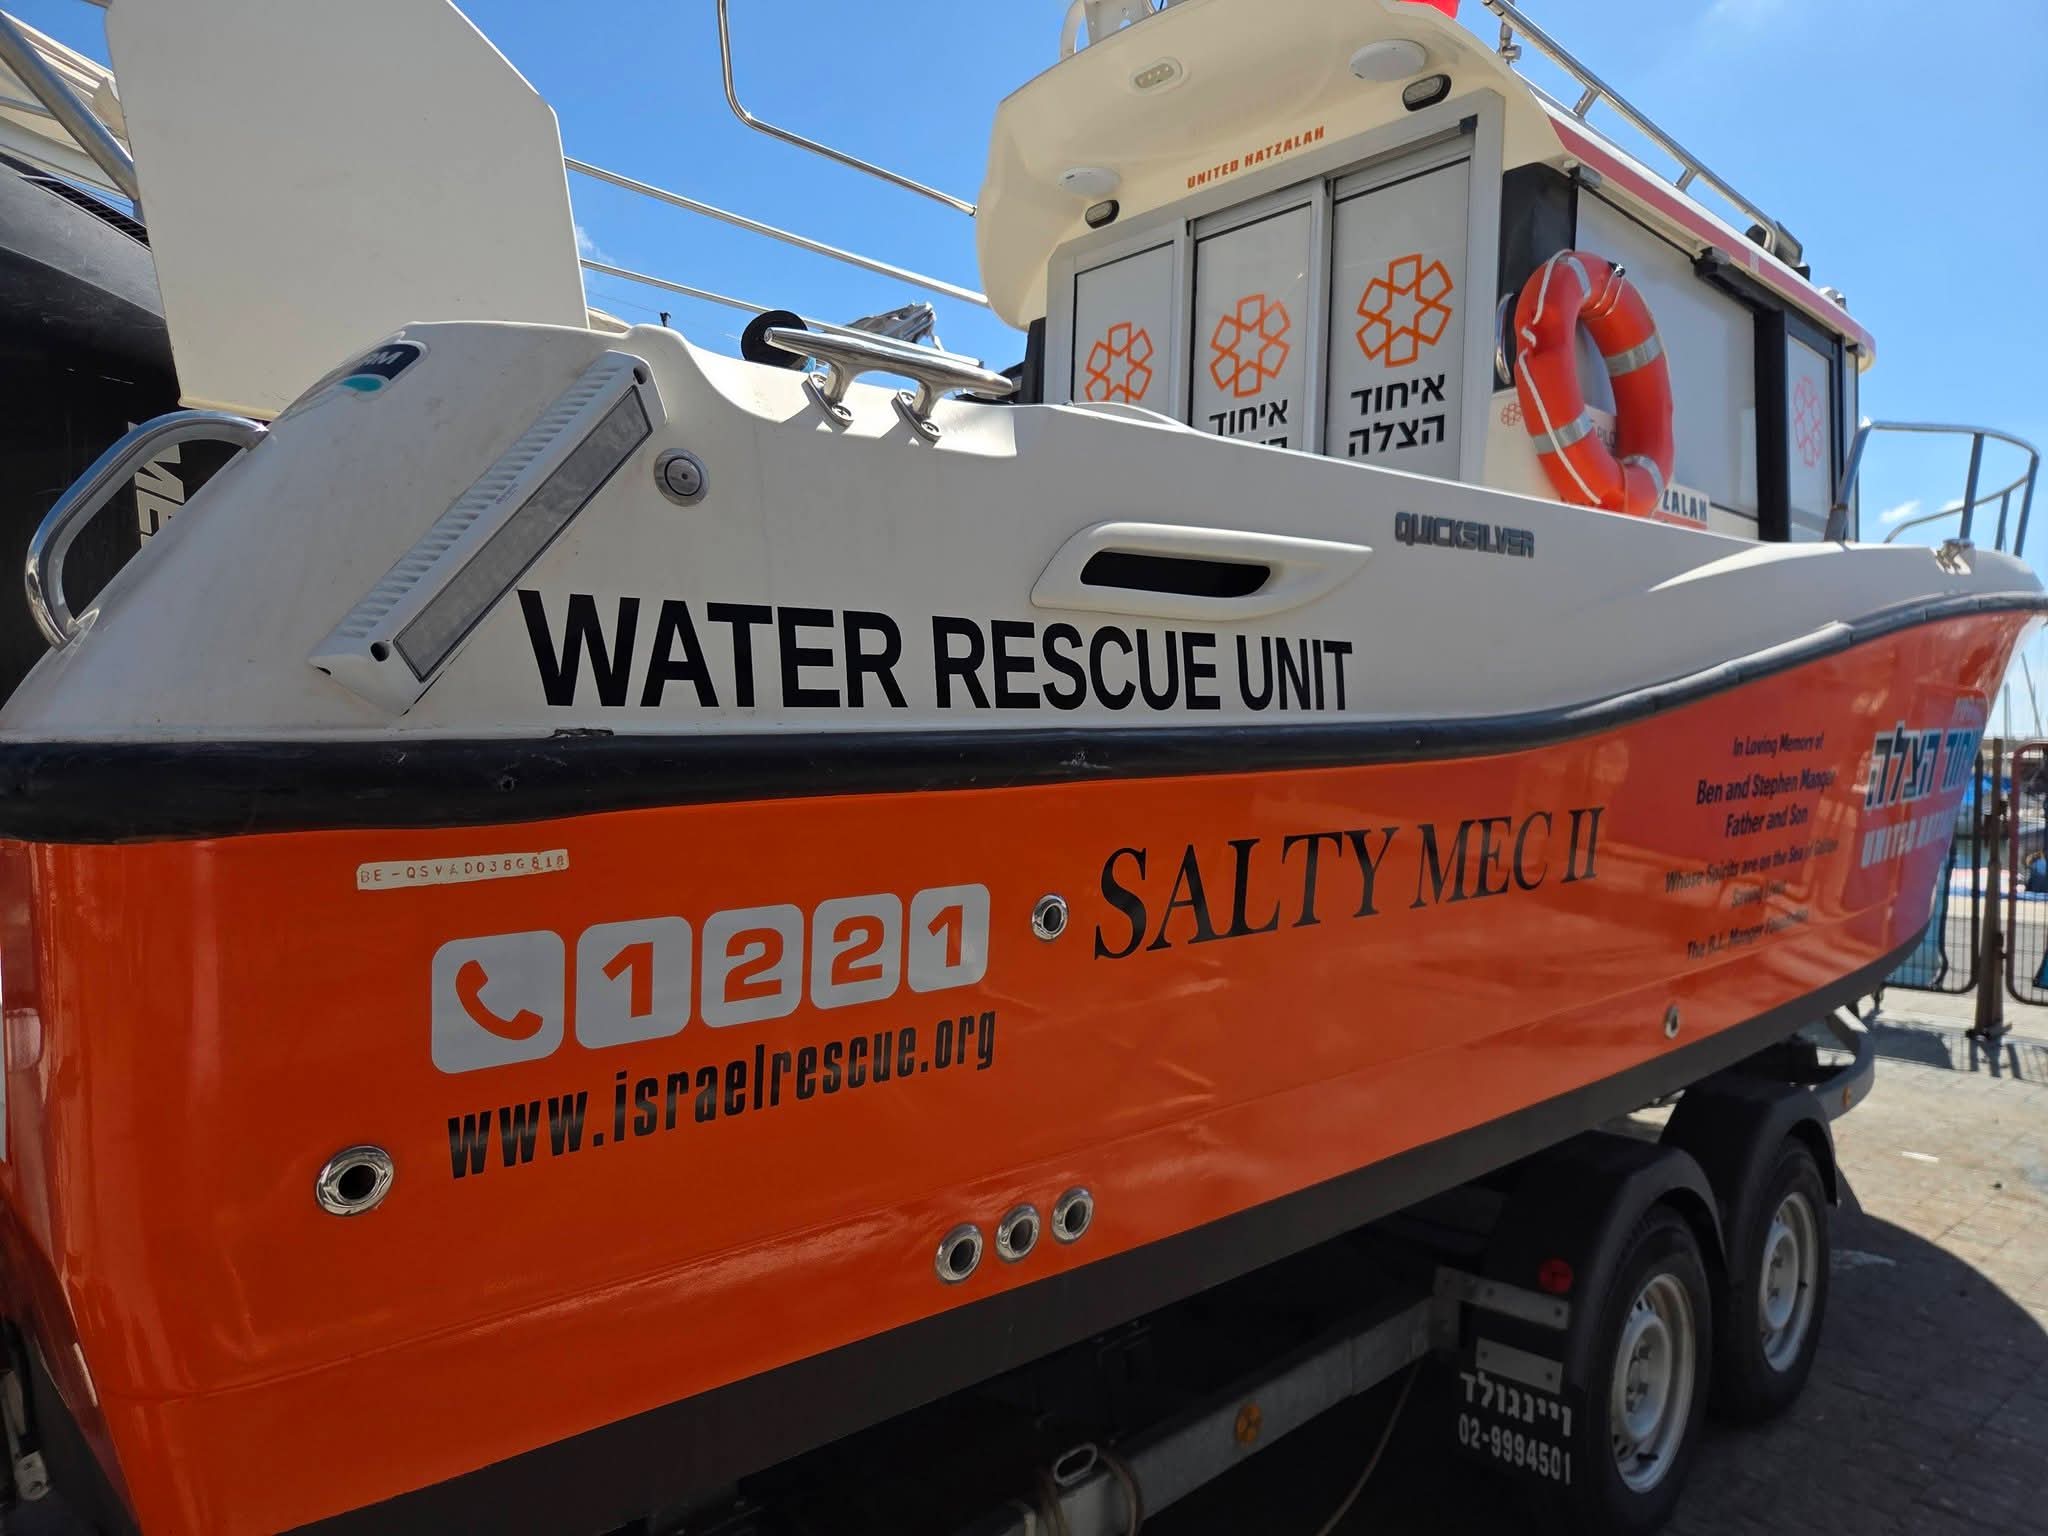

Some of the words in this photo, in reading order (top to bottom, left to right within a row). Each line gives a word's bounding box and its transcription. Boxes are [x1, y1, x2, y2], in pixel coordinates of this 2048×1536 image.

[1187, 159, 1239, 189] UNITED
[1244, 125, 1325, 168] HATZALAH
[1209, 399, 1289, 436] איחוד
[1351, 374, 1446, 416] איחוד
[1348, 414, 1446, 458] הצלה
[1395, 511, 1535, 559] QUICKSILVER
[516, 589, 908, 708] WATER
[932, 616, 1221, 711] RESCUE
[1236, 634, 1353, 711] UNIT
[1733, 736, 1743, 757] In
[1745, 735, 1777, 758] Loving
[1779, 732, 1813, 752] Memory
[1864, 720, 1943, 811] הצלה
[1696, 779, 1722, 805] Ben
[1726, 773, 1750, 801] and
[1752, 771, 1798, 800] Stephen
[1725, 811, 1765, 838] Father
[1766, 805, 1790, 830] and
[1790, 802, 1808, 826] Son
[1861, 818, 1917, 869] UNITED
[1094, 826, 1399, 961] SALTY
[1409, 811, 1553, 910] MEC
[1561, 807, 1605, 884] II
[1741, 857, 1759, 874] are
[447, 1010, 996, 1179] www.israelrescue.org
[1459, 1371, 1572, 1437] ויינגולד
[1458, 1412, 1571, 1486] 02-9994501
